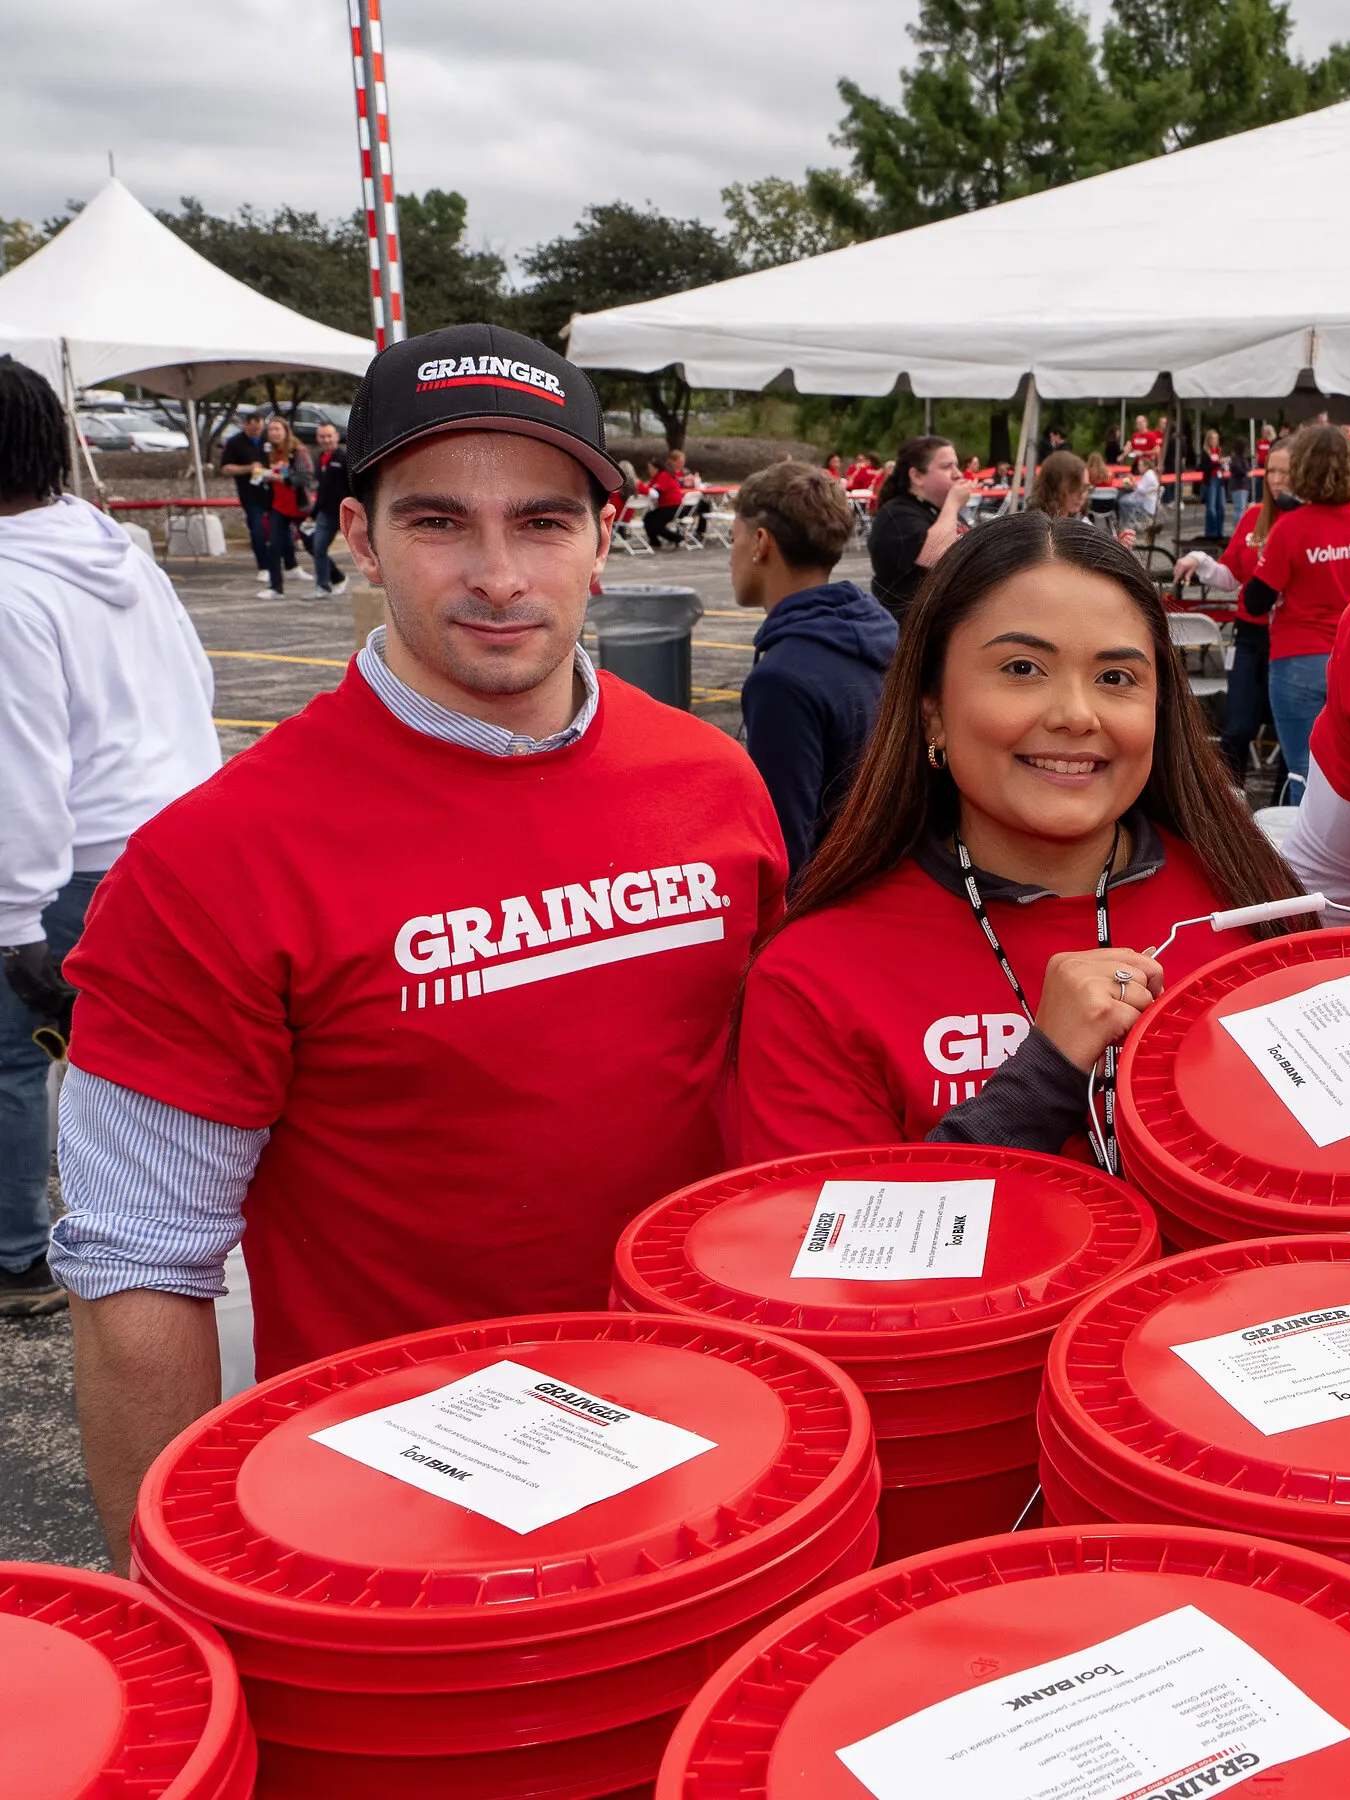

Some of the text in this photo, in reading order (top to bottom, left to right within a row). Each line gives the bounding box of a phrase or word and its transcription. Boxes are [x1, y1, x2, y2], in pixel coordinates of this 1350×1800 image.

[808, 1213, 835, 1252] GRAINGER
[1242, 1310, 1349, 1340] GRAINGER
[535, 1383, 629, 1422] GRAINGER
[1074, 1664, 1124, 1684] Tool
